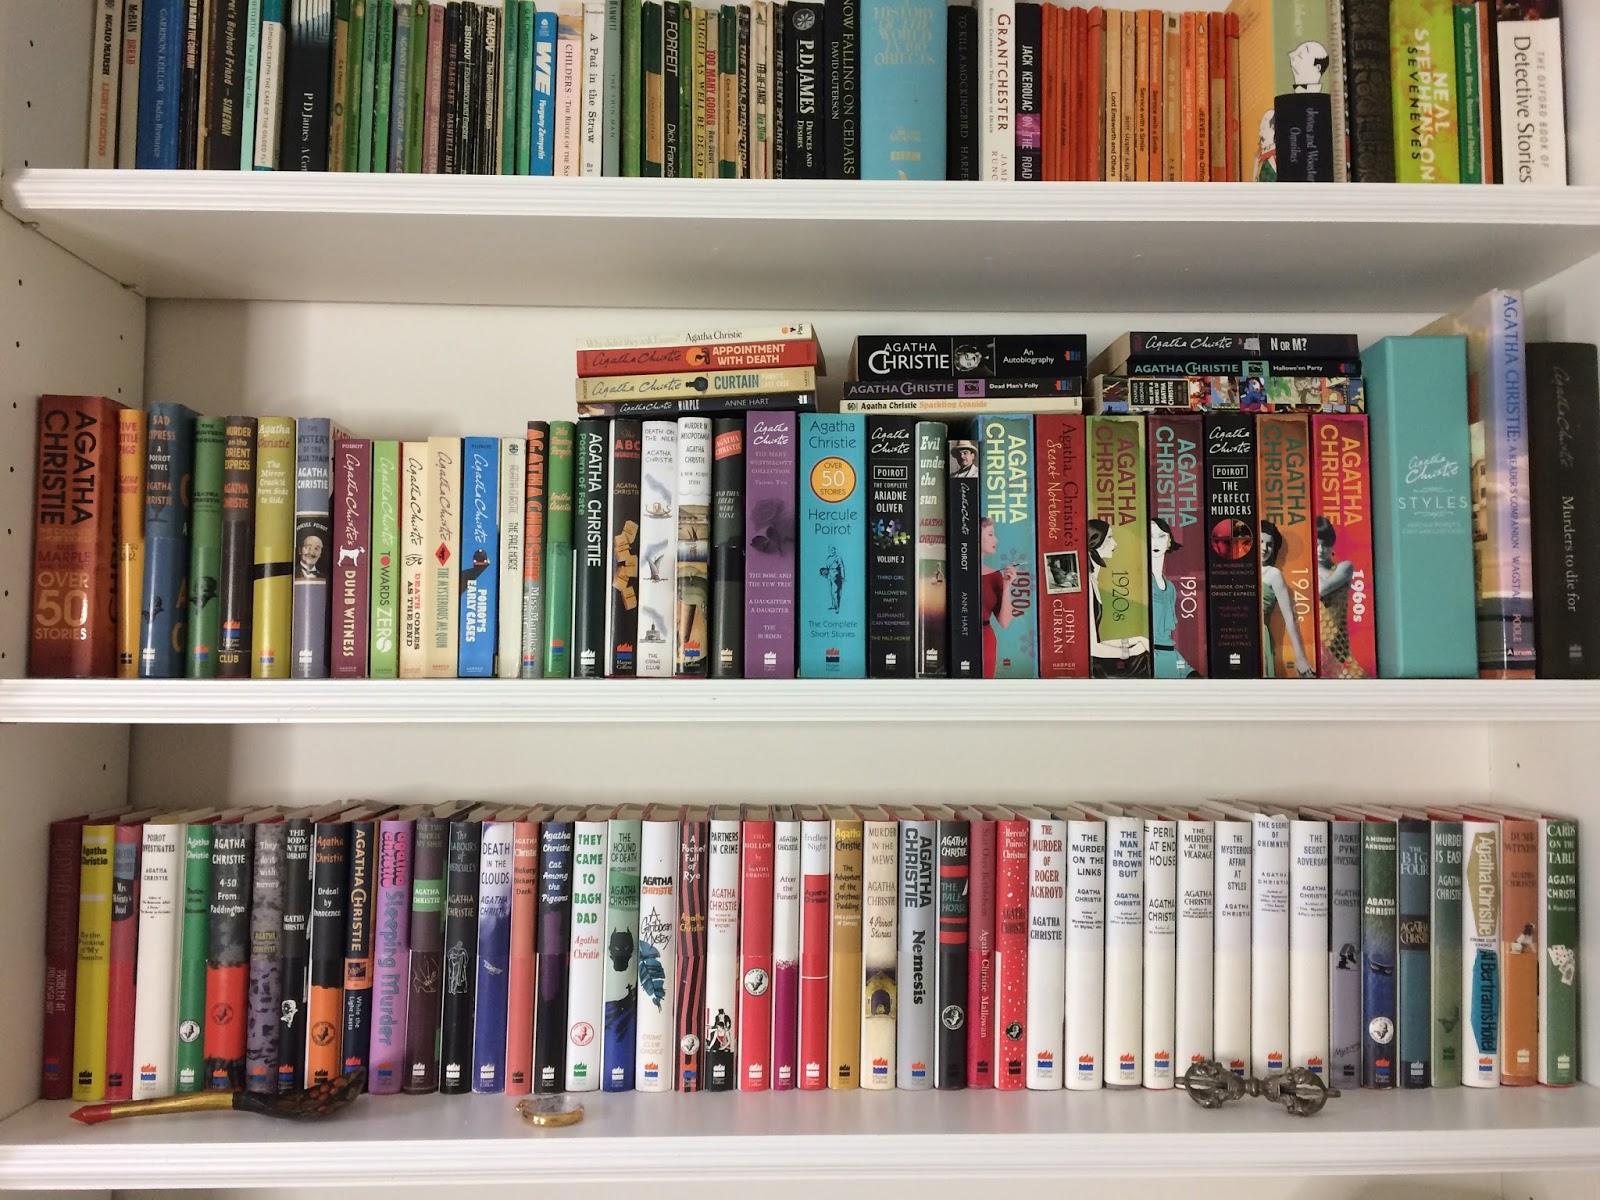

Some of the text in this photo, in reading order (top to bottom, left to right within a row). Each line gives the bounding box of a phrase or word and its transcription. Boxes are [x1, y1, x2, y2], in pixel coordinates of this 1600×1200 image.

[535, 42, 552, 96] WE
[564, 43, 574, 95] CHILDERS
[997, 14, 1011, 130] GRANTCHESTER
[665, 22, 679, 145] FORFEIT Dick
[831, 41, 840, 121] DAVID GUTERSON
[588, 33, 599, 144] A Pad in the Straw
[706, 65, 716, 126] MANY COOKS
[1433, 73, 1449, 130] NEAL
[842, 32, 856, 175] FALLING ON CEDARS
[1407, 47, 1421, 160] SEVENEVES
[1414, 28, 1436, 181] STEPHENSON
[1513, 36, 1535, 184] Detective Stories
[221, 97, 233, 137] SIMENON
[1021, 44, 1033, 179] JACK KEROUAC ON THE ROAD
[1504, 295, 1518, 365] AGATHA
[712, 344, 785, 355] APPOINTMENT
[884, 342, 937, 352] AGATHA
[1270, 338, 1279, 350] N
[1023, 348, 1034, 356] An
[717, 355, 780, 366] WITH DEATH
[868, 350, 950, 375] CHRISTIE
[1003, 356, 1055, 365] Autobiography
[1134, 362, 1239, 375] AGATHA CHRISTIE
[714, 374, 760, 390] CURTAIN
[849, 384, 899, 395] AGATHA
[900, 382, 954, 395] CHRISTIE
[1024, 382, 1039, 390] Folly
[724, 398, 769, 407] ANNE HART
[861, 401, 917, 411] Agatha Christie
[809, 421, 855, 434] Agatha
[616, 440, 641, 450] ABC
[809, 436, 856, 449] Christie
[920, 436, 940, 451] Evil
[41, 410, 69, 525] CHRISTIE
[71, 411, 97, 525] AGATHA
[920, 459, 945, 469] under
[878, 469, 904, 477] POIROT
[985, 422, 1007, 523] CHRISTIE
[1095, 426, 1116, 526] CHRISTIE
[1155, 426, 1176, 527] CHRISTIE
[1216, 467, 1244, 476] POIROT
[1264, 424, 1284, 526] CHRISTIE
[1320, 425, 1341, 526] CHRISTIE
[821, 471, 846, 487] 50
[920, 472, 936, 486] the
[1007, 434, 1027, 524] AGATHA
[1117, 438, 1137, 526] AGATHA
[1177, 438, 1198, 528] AGATHA
[1285, 438, 1306, 527] AGATHA
[1342, 437, 1363, 527] AGATHA
[1222, 482, 1238, 491] THE
[587, 433, 602, 567] AGATHA CHRISTIE
[874, 491, 907, 501] ARIADNE
[920, 495, 937, 505] sun
[1212, 494, 1250, 503] PERFECT
[877, 503, 903, 513] OLIVER
[1398, 497, 1468, 510] STYLES
[808, 509, 858, 520] Hercule
[1211, 506, 1252, 516] MURDERS
[815, 524, 851, 535] Poirot
[960, 542, 968, 571] POIROT
[1562, 495, 1580, 612] Murders to die for
[38, 572, 89, 588] OVER
[407, 581, 413, 598] AS
[1351, 569, 1366, 623] 1960s
[1112, 571, 1130, 622] 1920s
[1180, 576, 1197, 619] 1930s
[35, 590, 88, 627] 50
[342, 570, 356, 657] DUMB WITNESS
[466, 579, 477, 642] EARLY CASES
[1052, 599, 1063, 654] CURRAN
[1063, 609, 1075, 644] JOHN
[35, 628, 87, 640] STORIES
[219, 654, 239, 663] CLUB
[1041, 825, 1053, 835] THE
[578, 834, 602, 845] THEY
[711, 832, 739, 842] PARTNERS
[1081, 834, 1098, 842] THE
[214, 839, 246, 849] AGATHA
[483, 843, 510, 855] DEATH
[710, 844, 739, 855] IN CRIME
[1032, 840, 1063, 852] MURDER
[1149, 842, 1159, 852] AT
[212, 854, 246, 865] CHRISTIE
[487, 860, 507, 868] IN THE
[576, 854, 603, 865] CAME
[871, 854, 894, 864] MEWS
[1043, 857, 1051, 866] OF
[1475, 837, 1494, 883] Agatha
[905, 827, 918, 908] CHRISTIE
[919, 836, 932, 908] AGATHA
[1077, 868, 1102, 876] LINKS
[1118, 870, 1138, 878] SUIT
[482, 872, 510, 885] CLOUDS
[583, 874, 596, 884] TO
[642, 876, 673, 886] AGATHA
[1034, 870, 1059, 882] ROGER
[351, 829, 367, 952] AGATHA CHRISTIE
[711, 888, 736, 898] AGATHA
[1030, 886, 1063, 899] ACKROYD
[574, 893, 602, 904] BAGH
[709, 900, 737, 911] CHRISTIE
[576, 912, 598, 924] DAD
[1032, 917, 1060, 927] AGATHA
[1030, 930, 1062, 941] CHRISTIE
[912, 930, 926, 1005] Nemesis
